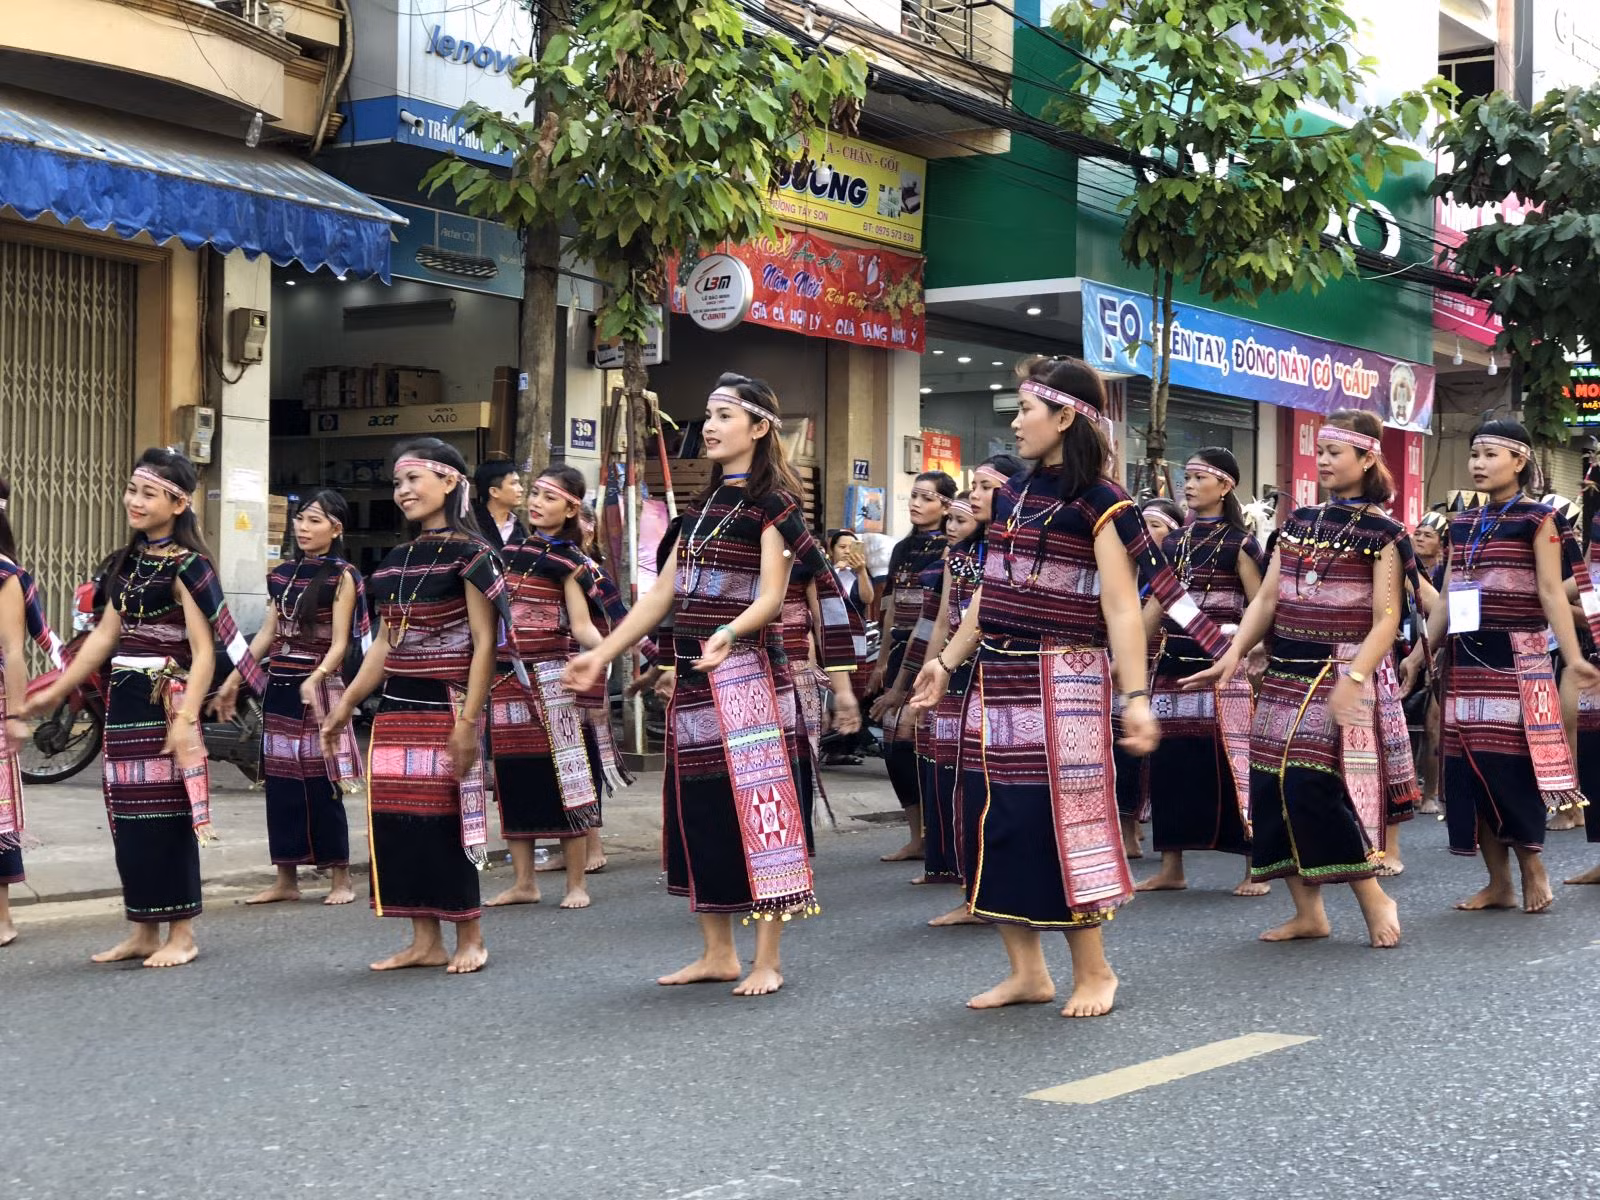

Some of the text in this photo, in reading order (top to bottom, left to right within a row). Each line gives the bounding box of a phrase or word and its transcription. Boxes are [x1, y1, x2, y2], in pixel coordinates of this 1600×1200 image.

[426, 25, 516, 73] lenov
[427, 115, 456, 145] TRẦN
[763, 263, 790, 293] Năm
[701, 312, 726, 321] Canon
[810, 311, 822, 331] LÝ
[860, 321, 888, 342] TẶNG
[1195, 332, 1228, 375] TAY,
[1234, 338, 1277, 378] ĐÔNG
[1279, 346, 1310, 386] NÀY
[1313, 354, 1332, 390] CÓ
[368, 413, 458, 427] acer VAIO
[575, 421, 592, 437] 39
[1299, 418, 1315, 457] GIÁ
[855, 460, 867, 474] 77
